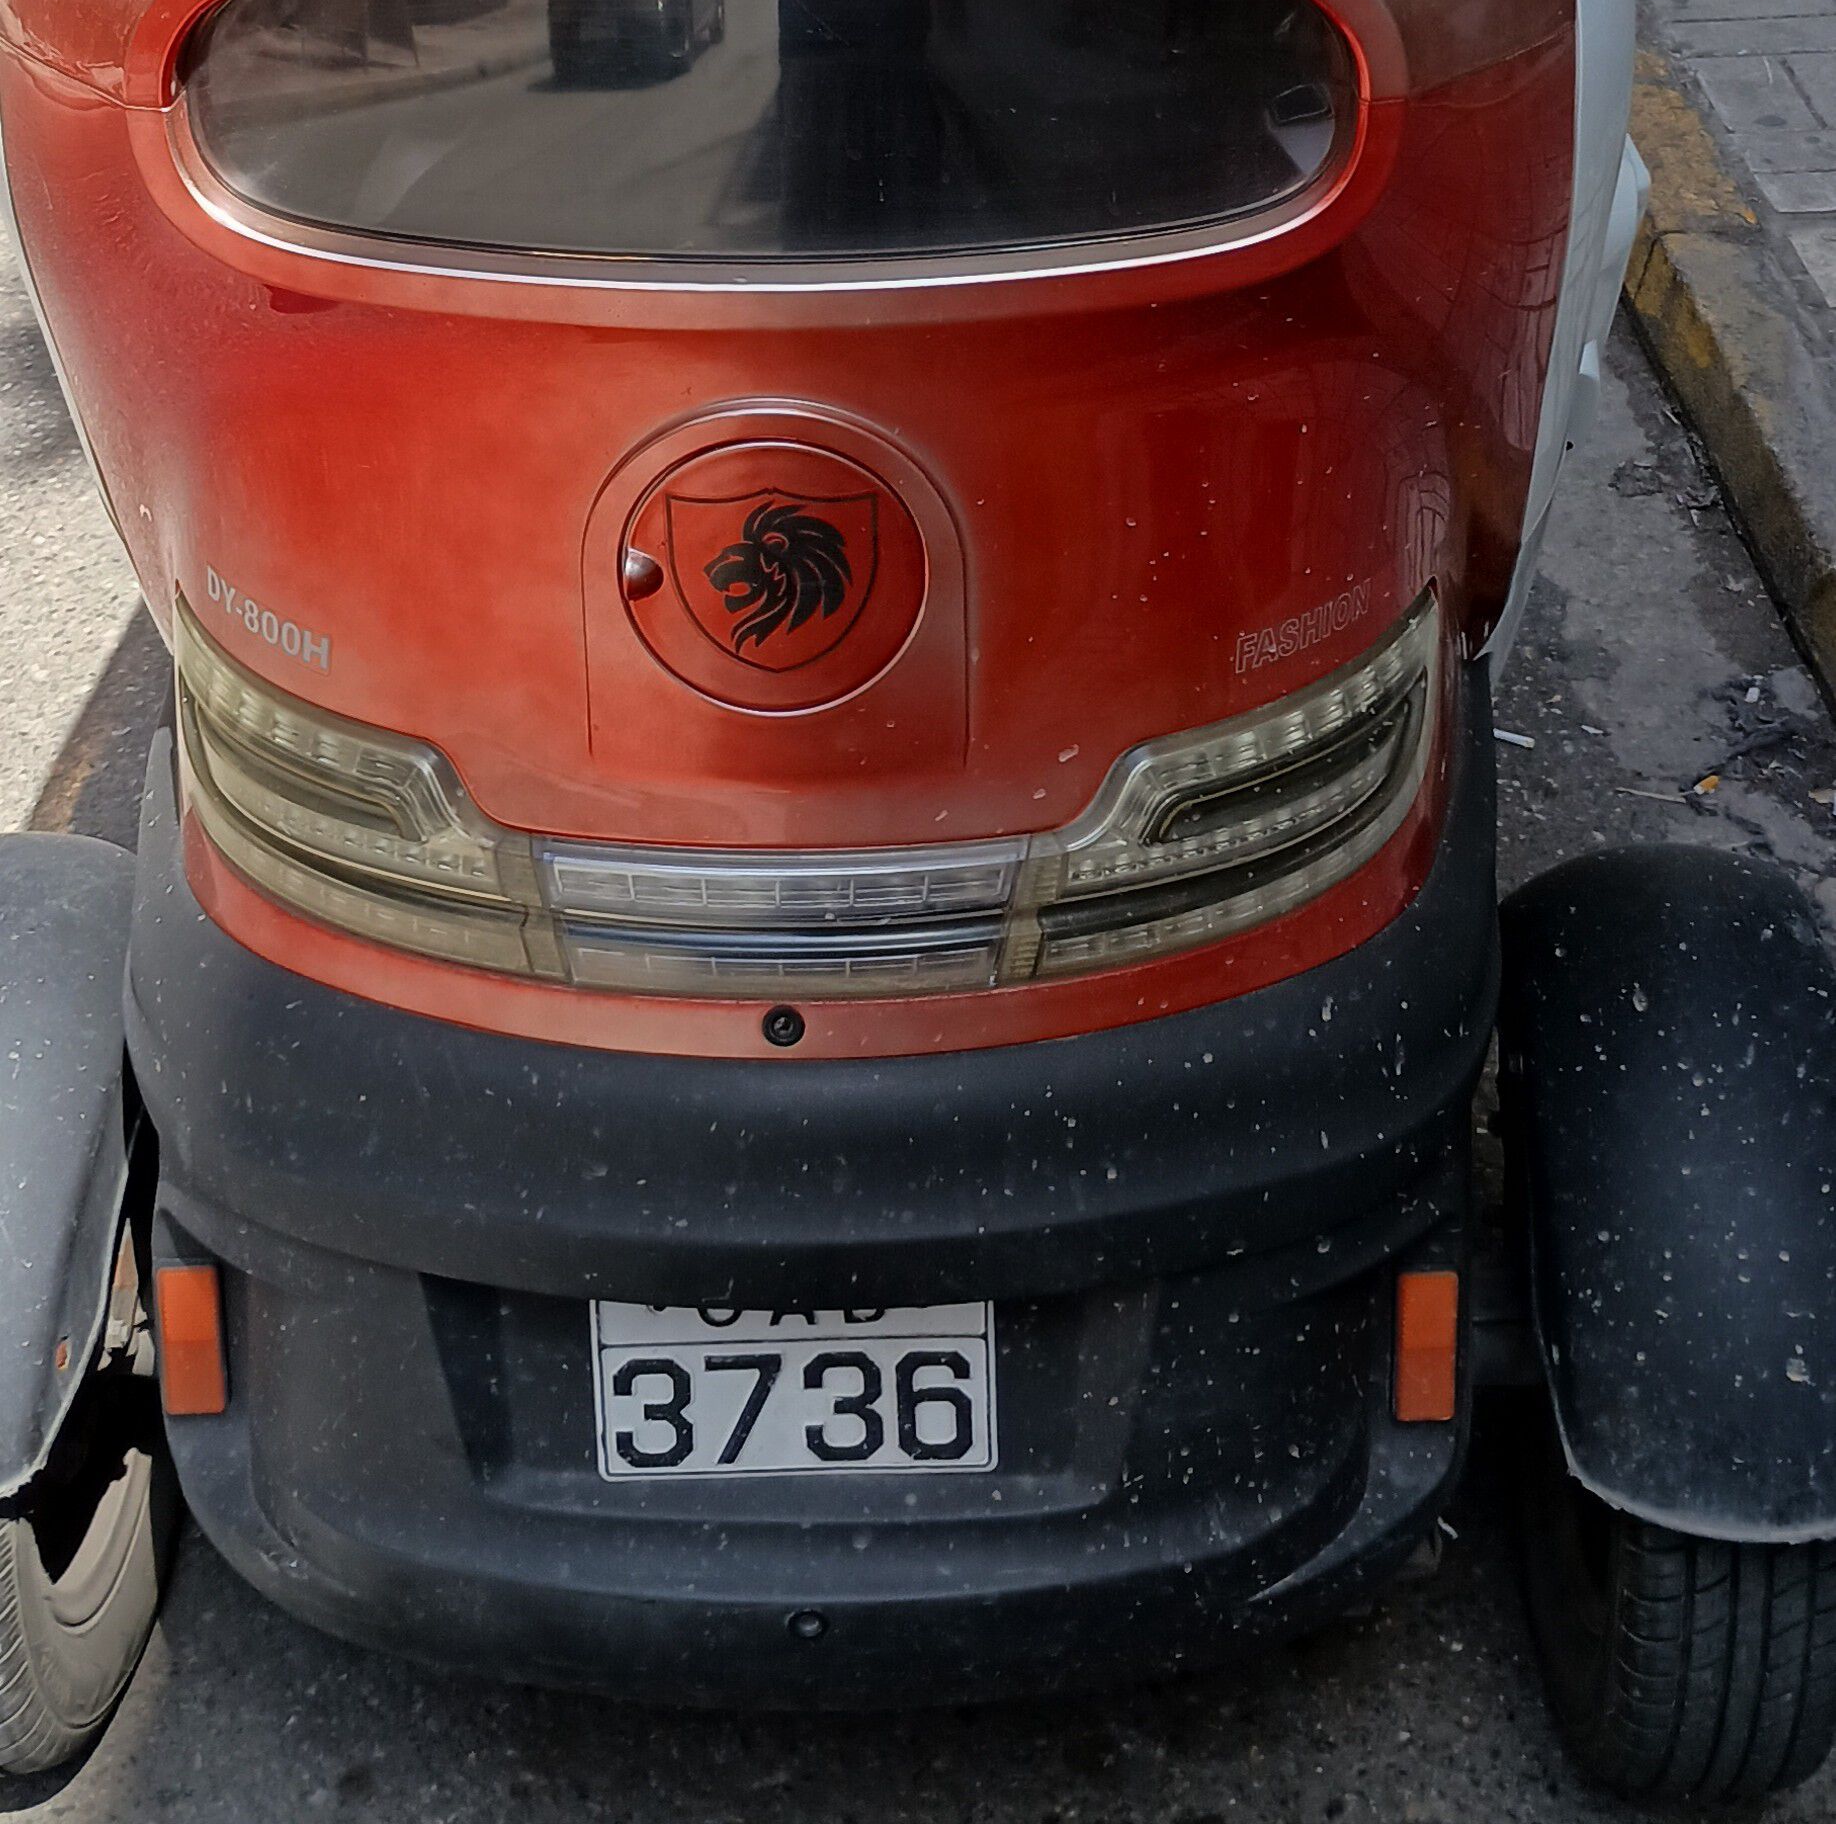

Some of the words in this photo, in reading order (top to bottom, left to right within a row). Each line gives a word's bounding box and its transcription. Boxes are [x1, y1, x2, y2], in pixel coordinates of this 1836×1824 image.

[206, 564, 330, 671] DY-800H
[1235, 577, 1373, 674] FASHION
[612, 1350, 974, 1469] 3736
